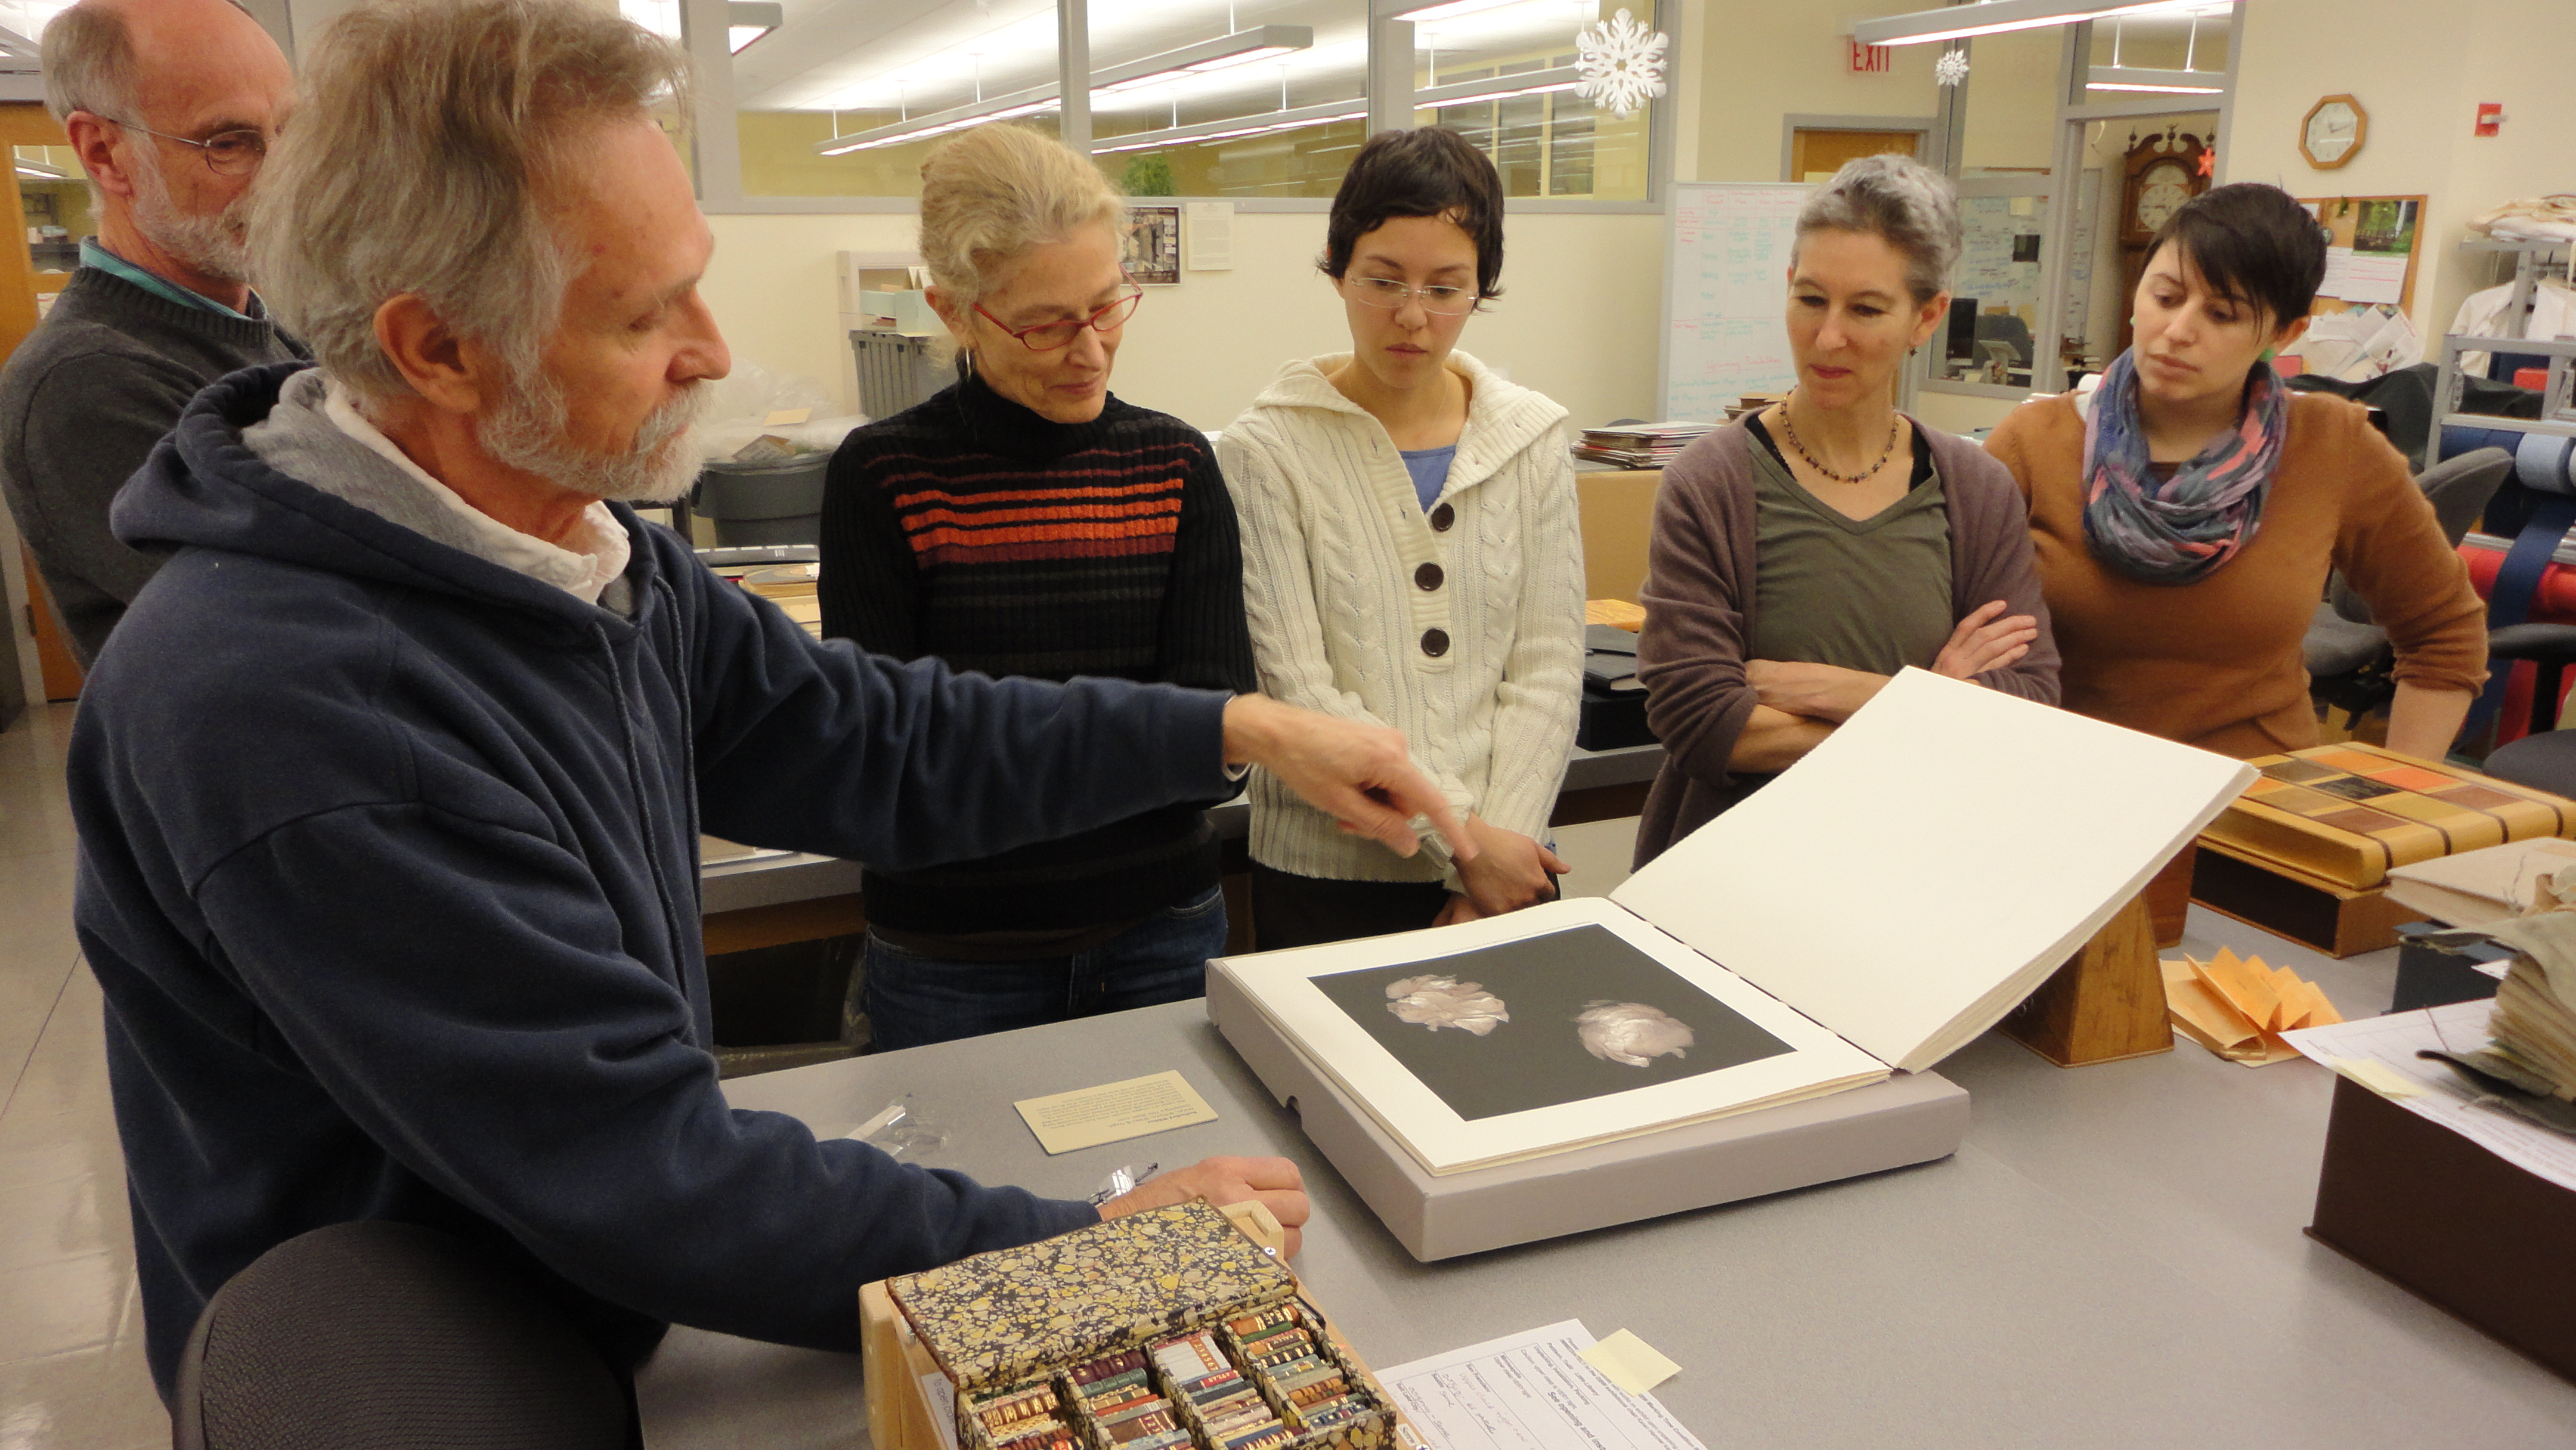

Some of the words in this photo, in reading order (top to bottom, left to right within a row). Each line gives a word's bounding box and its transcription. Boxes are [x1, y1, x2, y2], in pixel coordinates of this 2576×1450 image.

[1853, 41, 1890, 72] EXIT
[1547, 1391, 1560, 1403] See
[1558, 1403, 1583, 1427] opening
[1580, 1427, 1596, 1439] and
